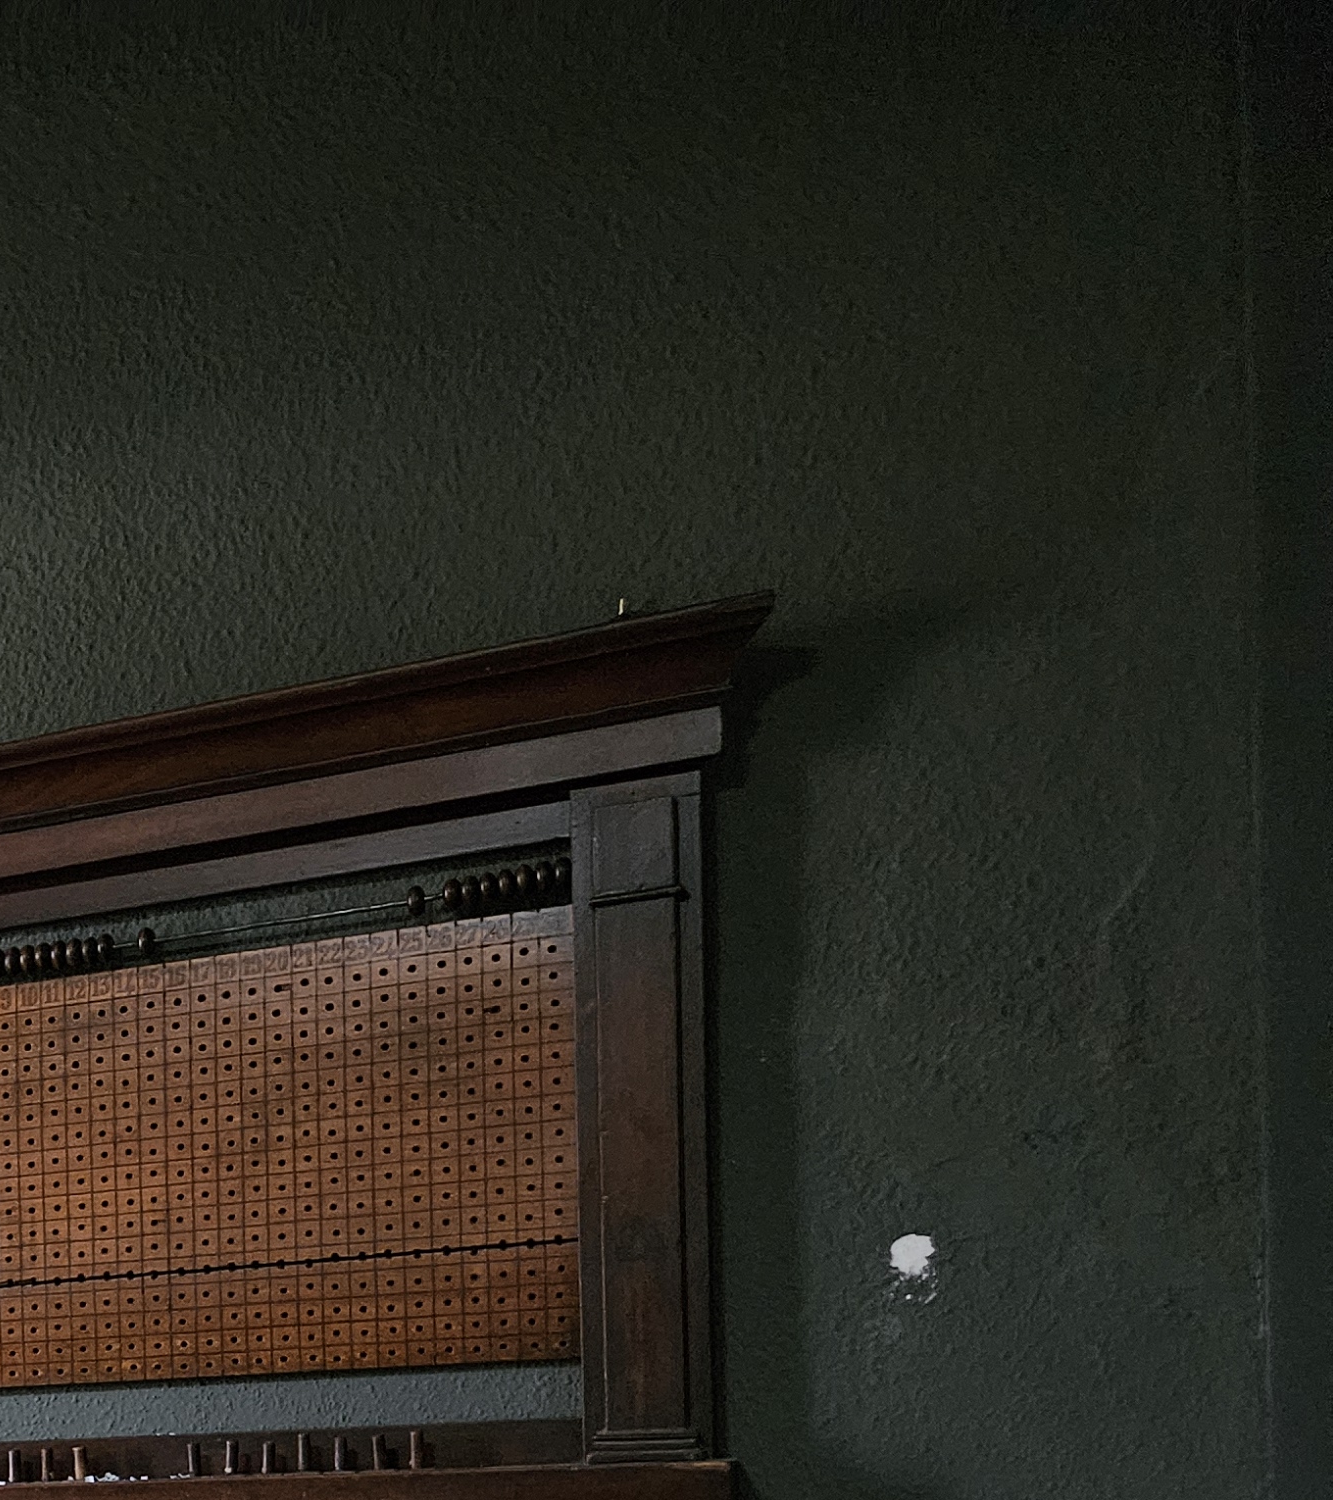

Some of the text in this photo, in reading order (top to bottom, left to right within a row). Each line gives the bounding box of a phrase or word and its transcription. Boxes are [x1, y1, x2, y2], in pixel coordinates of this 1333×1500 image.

[0, 988, 11, 1010] 9
[19, 985, 39, 1007] 10
[42, 982, 60, 1004] 11
[68, 978, 86, 1001] 12
[90, 974, 110, 997] 13
[140, 966, 161, 989] 15
[192, 961, 210, 982] 17
[265, 949, 289, 973] 20
[293, 946, 313, 968] 21
[317, 942, 341, 965] 22
[399, 929, 423, 953] 25
